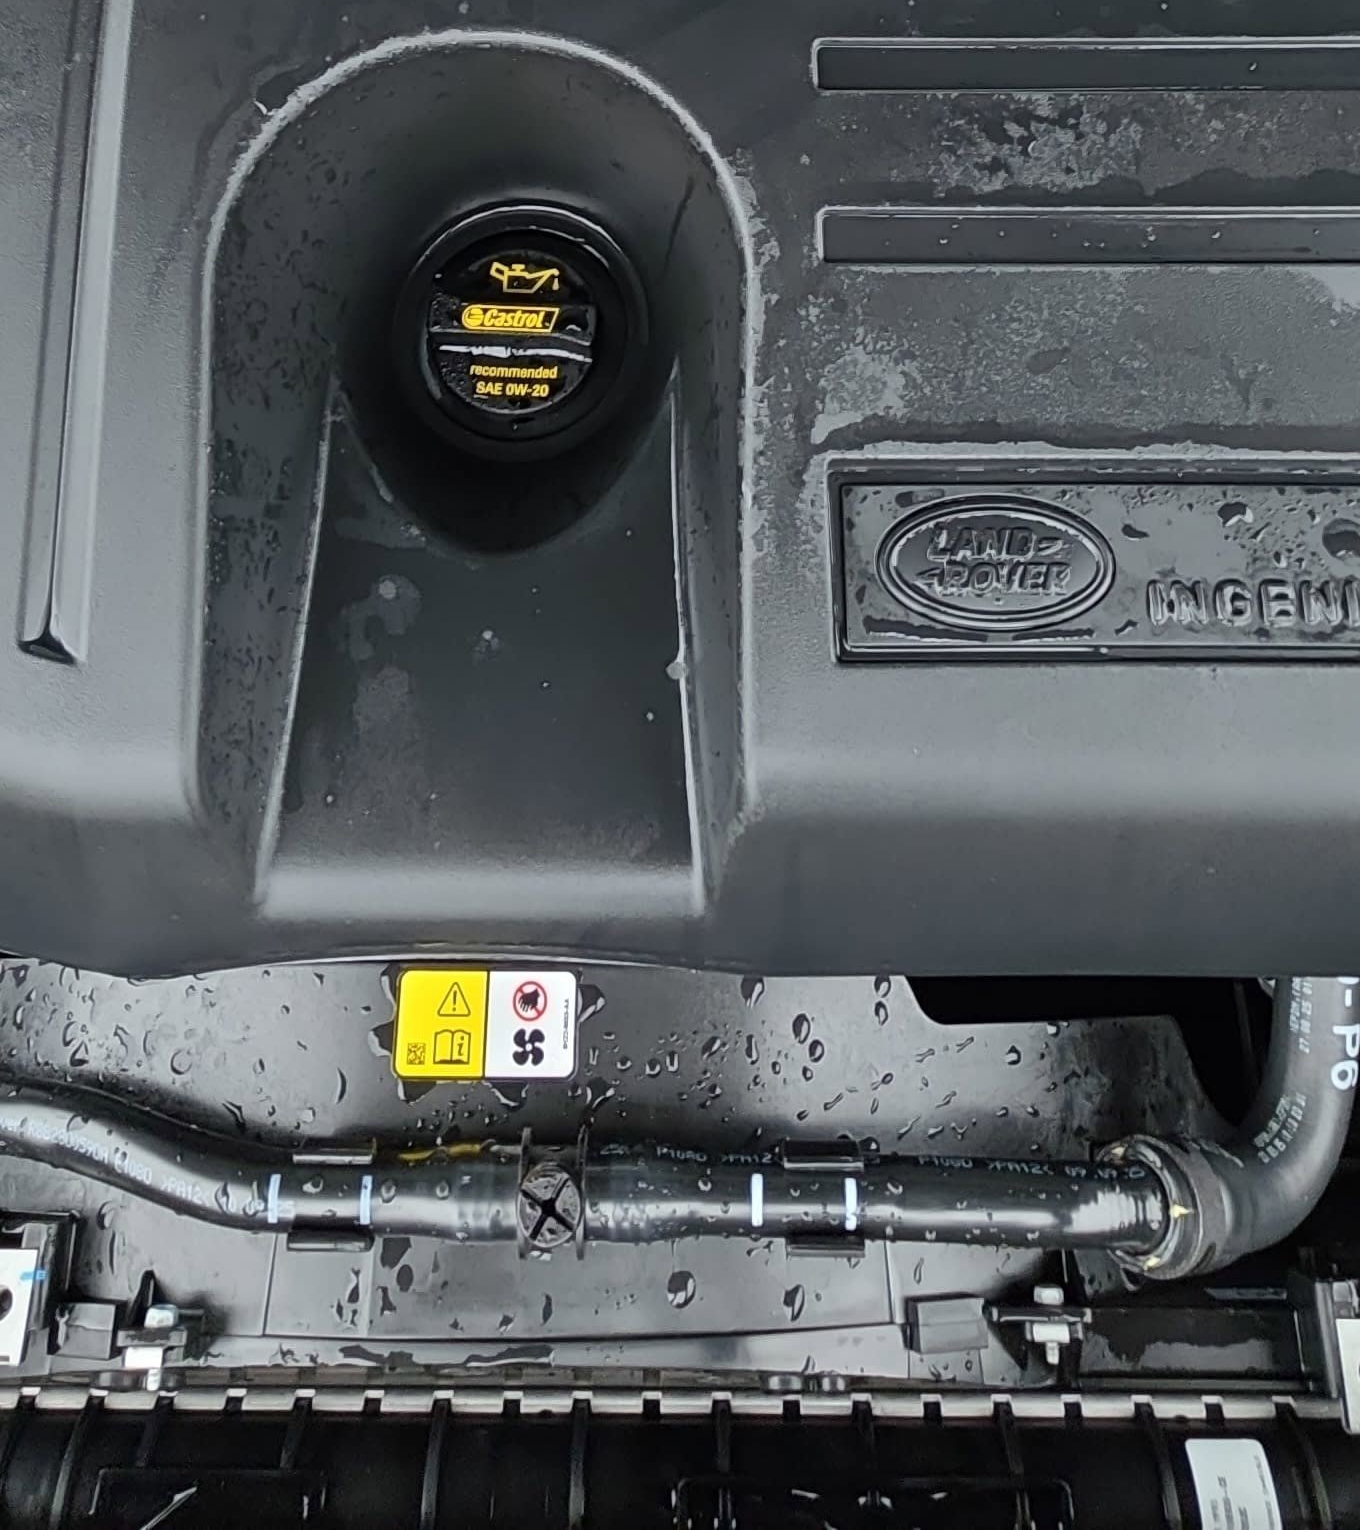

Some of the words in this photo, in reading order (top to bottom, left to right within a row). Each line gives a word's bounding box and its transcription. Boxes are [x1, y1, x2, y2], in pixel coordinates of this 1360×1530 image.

[484, 308, 545, 329] Castrol
[469, 363, 558, 380] recommended
[475, 381, 503, 396] SAE
[505, 382, 550, 398] 0W-20
[927, 523, 1035, 561] LAND
[936, 561, 1070, 597] ROVER
